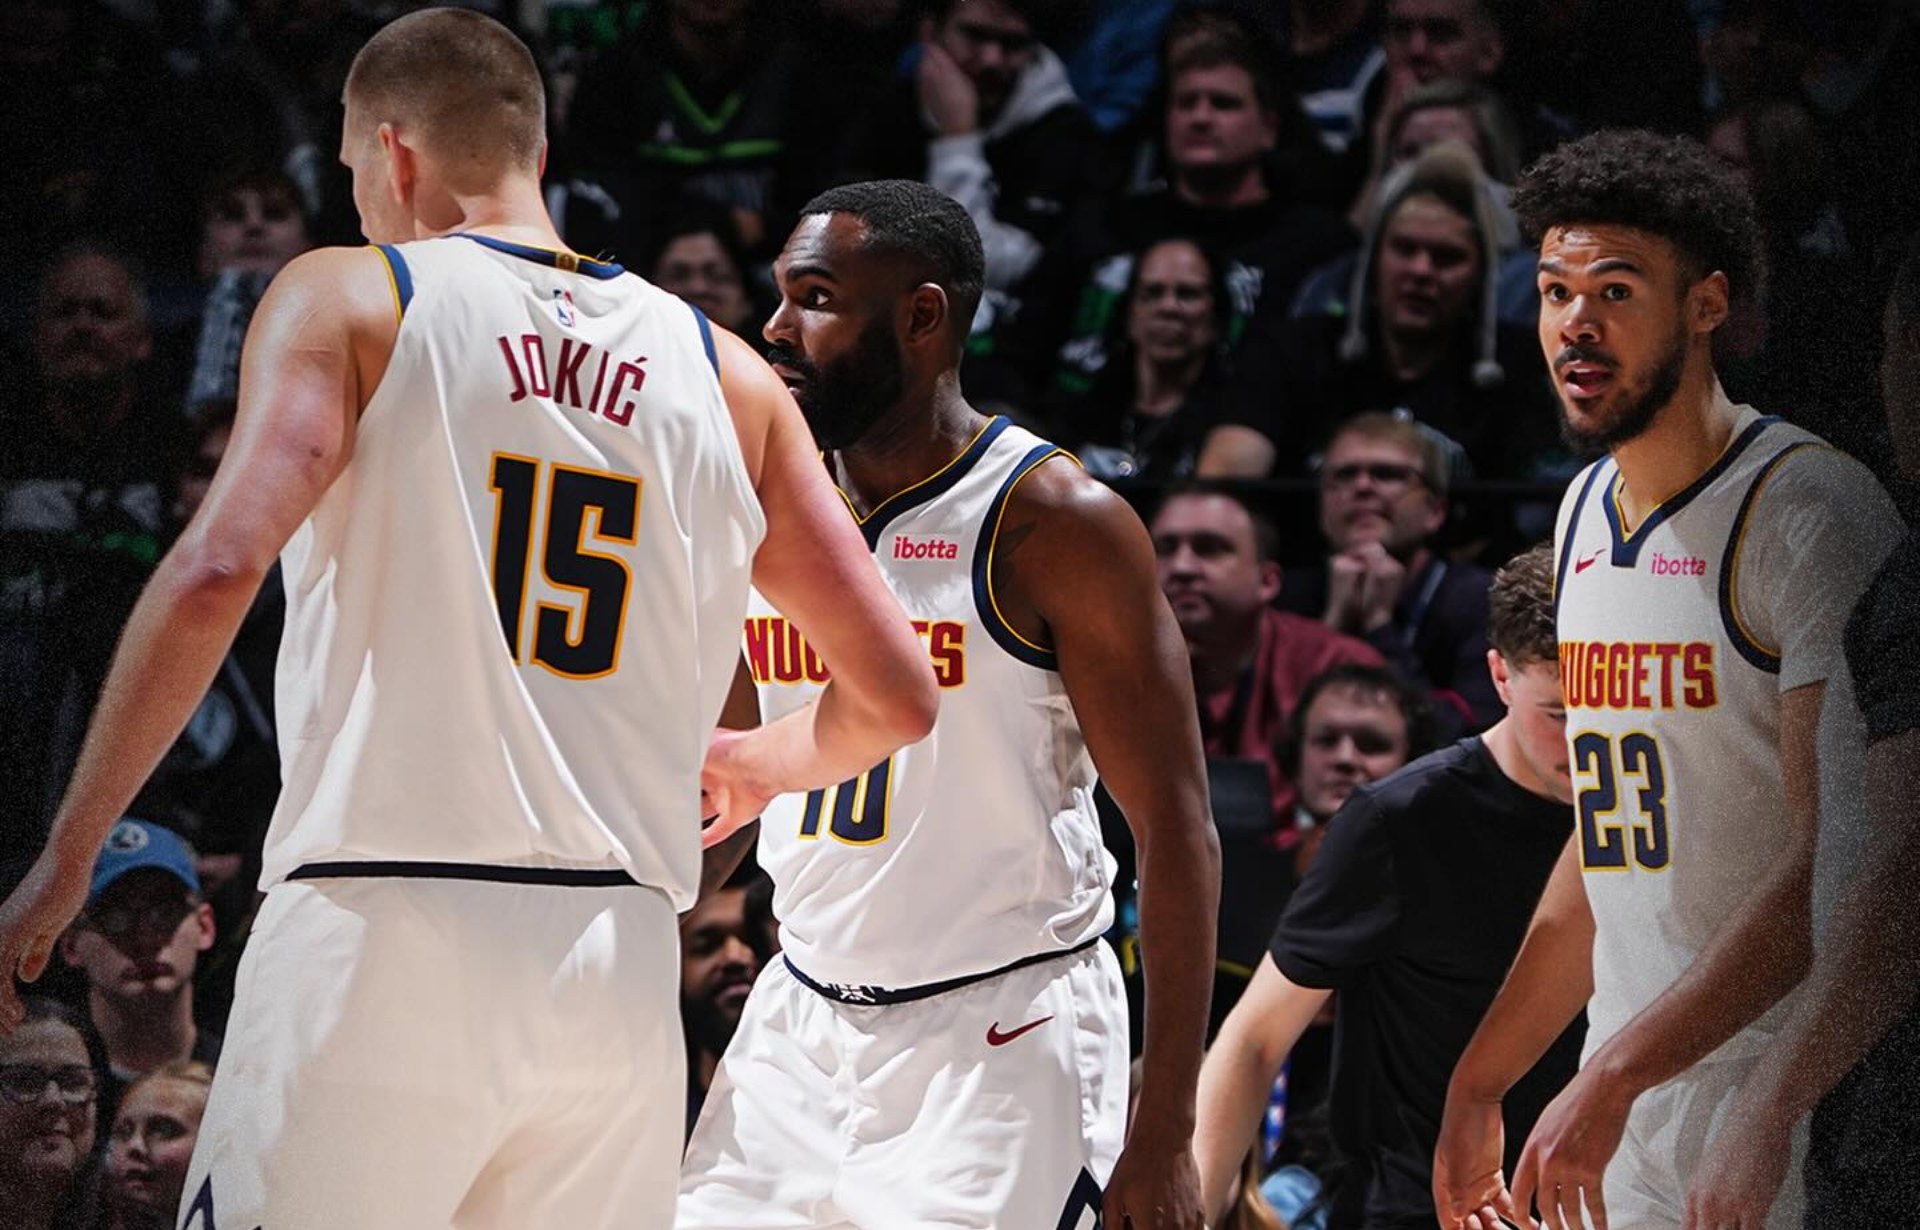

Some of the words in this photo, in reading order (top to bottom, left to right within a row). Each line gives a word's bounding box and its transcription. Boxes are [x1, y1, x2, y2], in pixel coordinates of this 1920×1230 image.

[498, 334, 648, 427] JOKIĆ
[489, 451, 642, 680] 15
[894, 535, 958, 559] ibotta
[1651, 552, 1706, 576] ibotta
[1571, 729, 1672, 873] 23
